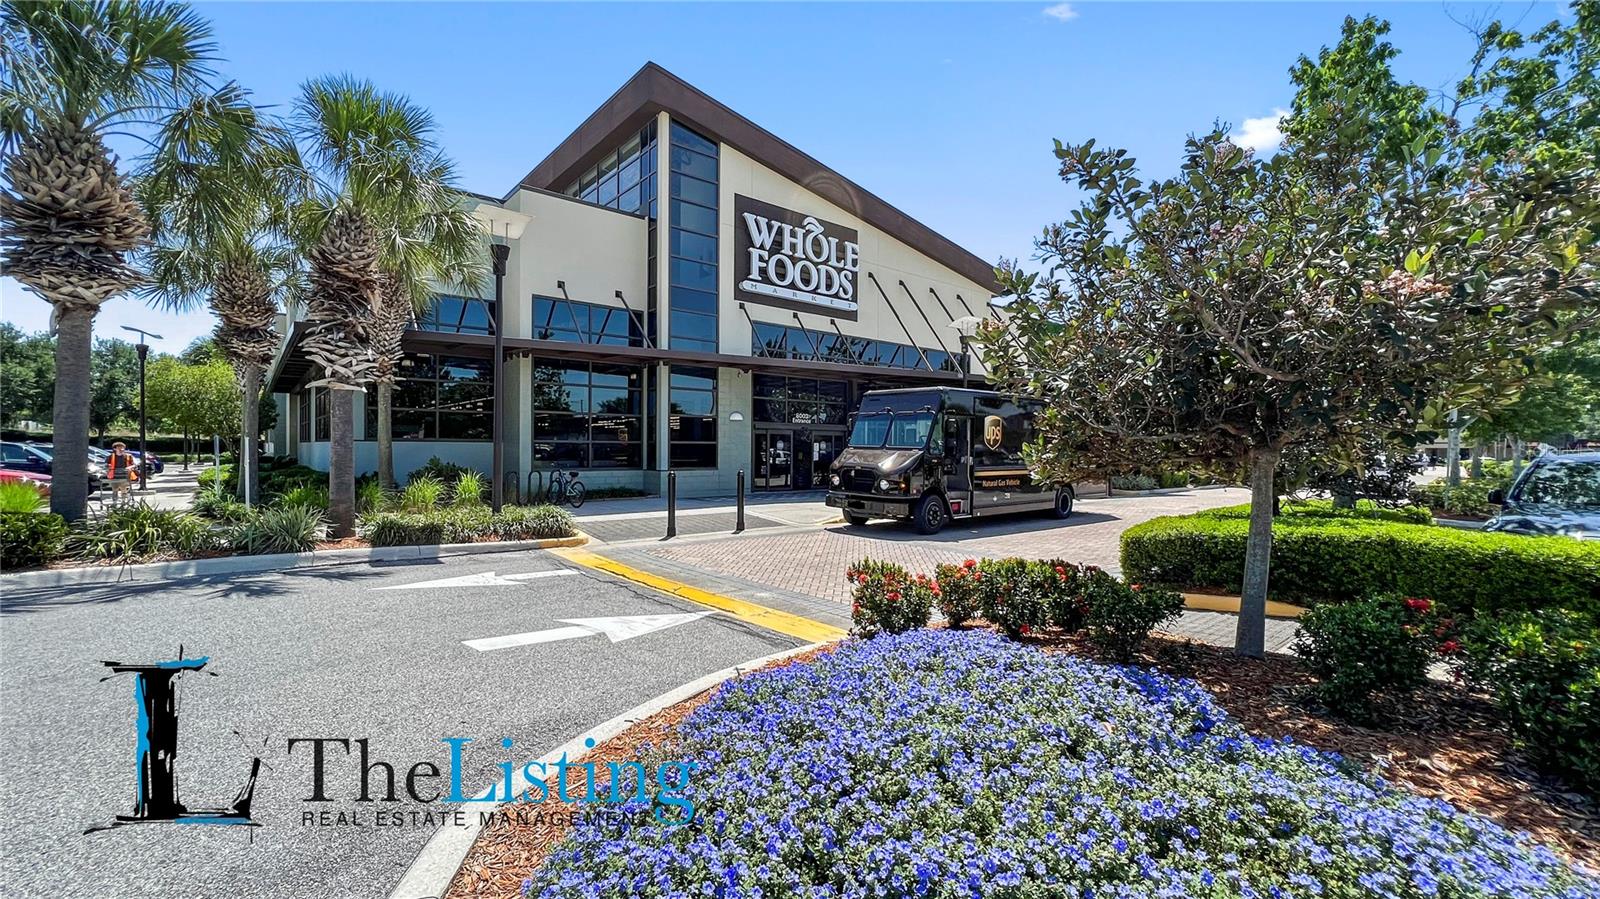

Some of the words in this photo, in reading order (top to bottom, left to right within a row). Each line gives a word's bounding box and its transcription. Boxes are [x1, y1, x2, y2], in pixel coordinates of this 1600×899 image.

[742, 212, 860, 272] WHOLE
[747, 247, 853, 300] FOODS
[750, 283, 853, 308] MARKET
[985, 426, 1001, 445] ups
[982, 480, 997, 488] Natural
